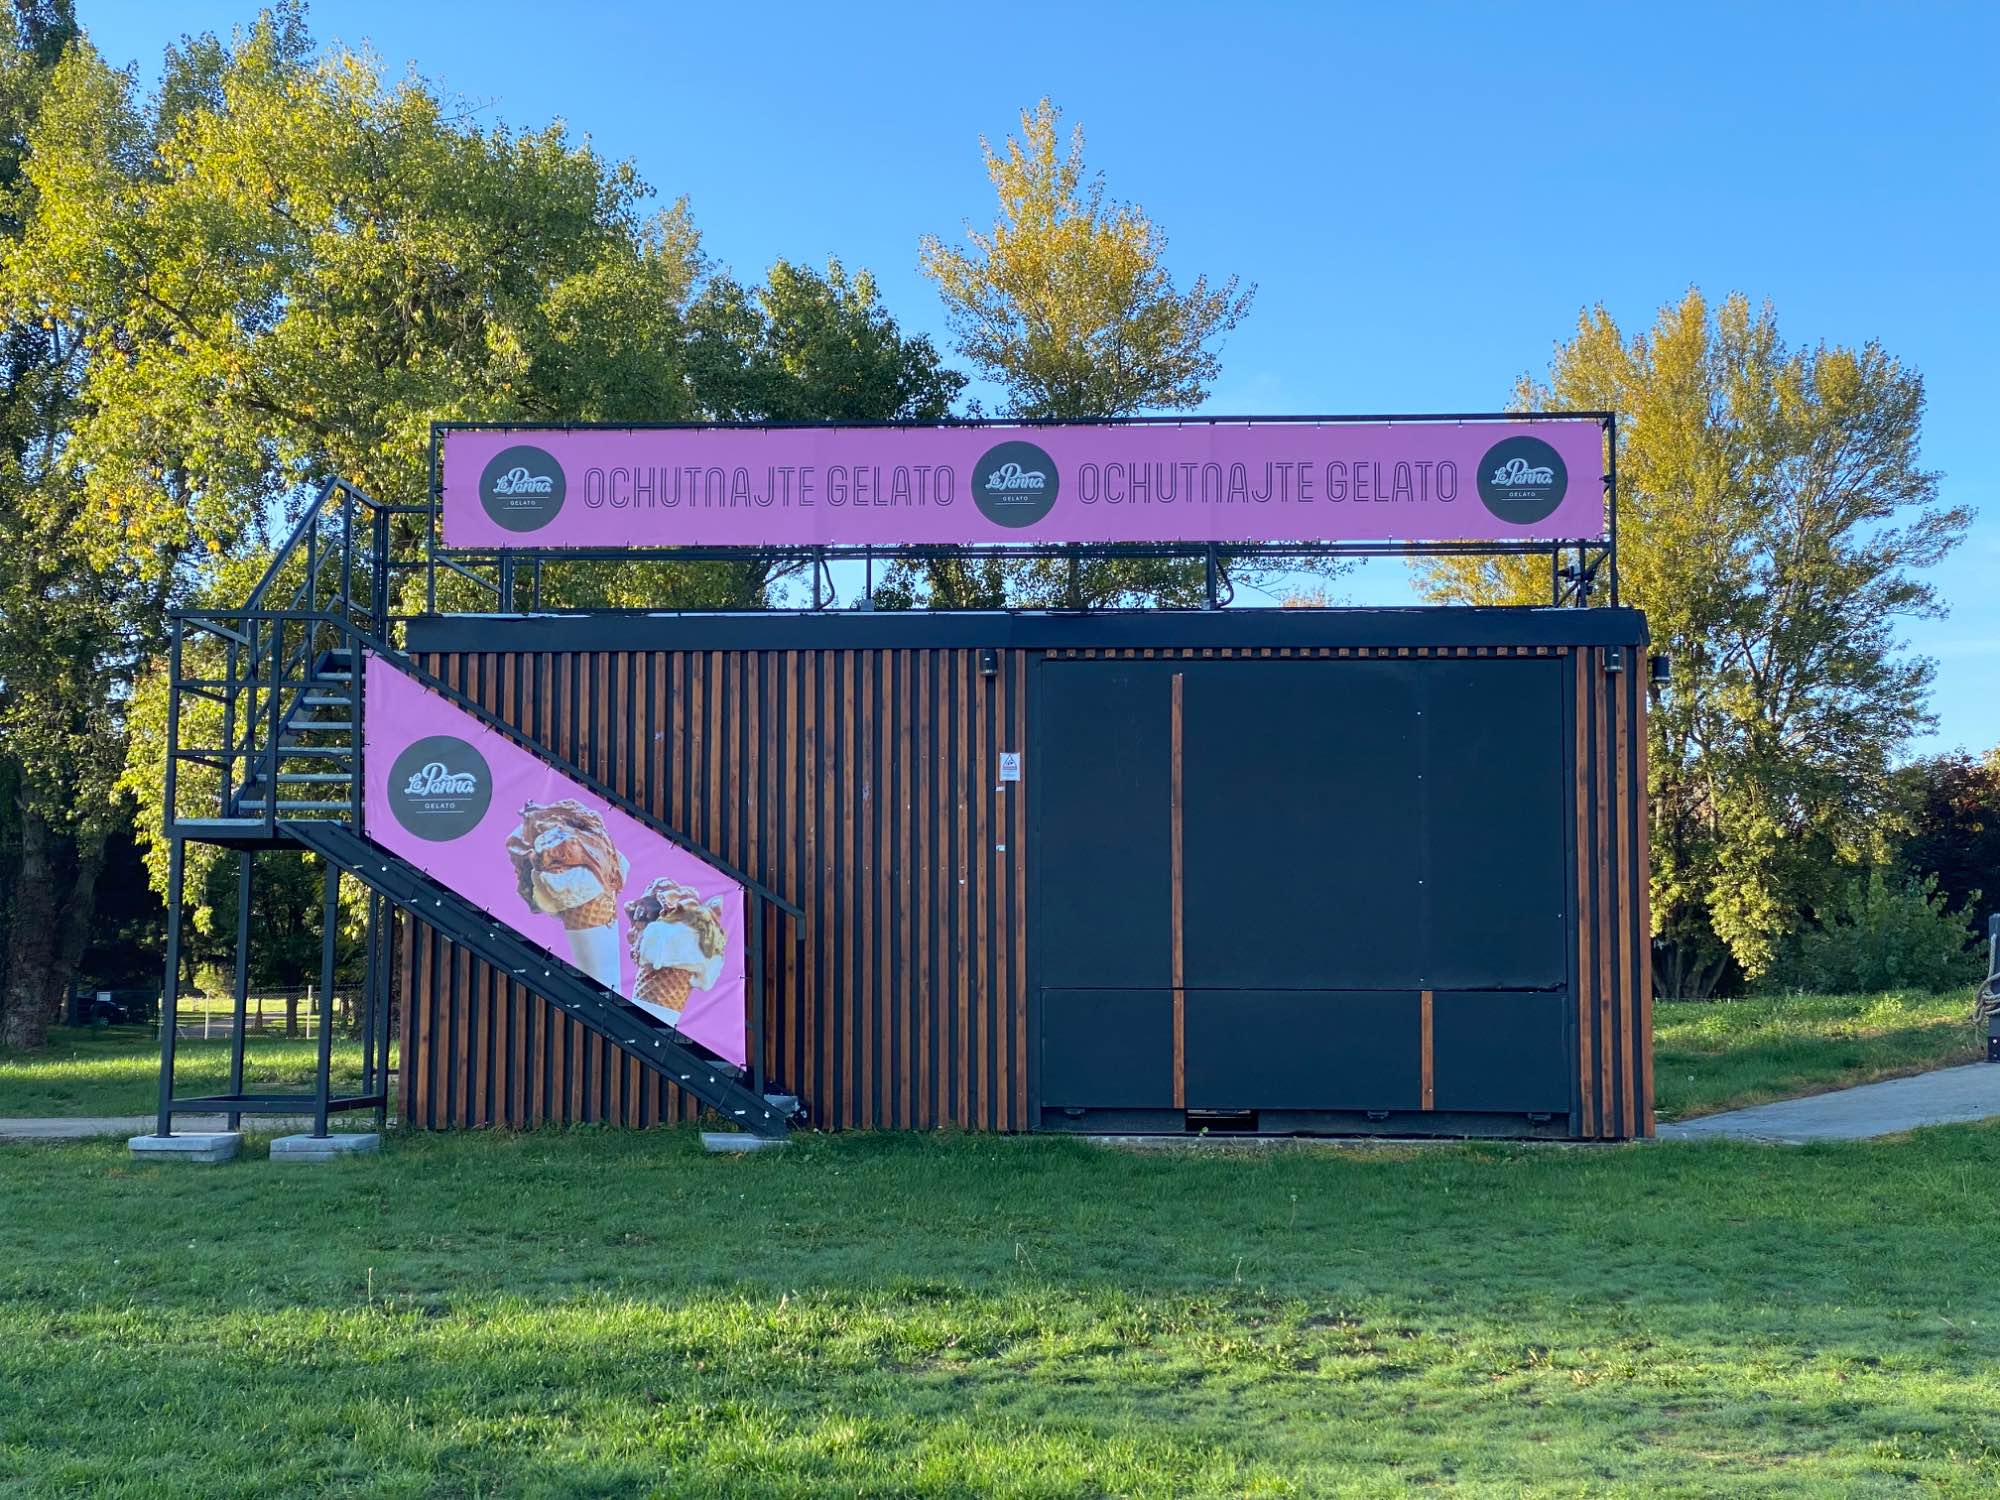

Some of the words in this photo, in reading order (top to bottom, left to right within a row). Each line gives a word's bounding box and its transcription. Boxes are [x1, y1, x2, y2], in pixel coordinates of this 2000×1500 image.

[493, 475, 510, 494] La
[508, 467, 554, 495] Panna
[584, 466, 815, 509] OCHUTNAJTE
[827, 465, 955, 507] GELATO
[985, 470, 1002, 490] La
[1000, 462, 1047, 491] Panna
[1078, 461, 1314, 505] OCHUTNAJTE
[1326, 460, 1458, 503] GELATO
[1491, 466, 1508, 486] La
[1506, 457, 1554, 487] Panna
[404, 772, 424, 795] La
[422, 762, 477, 797] Panna
